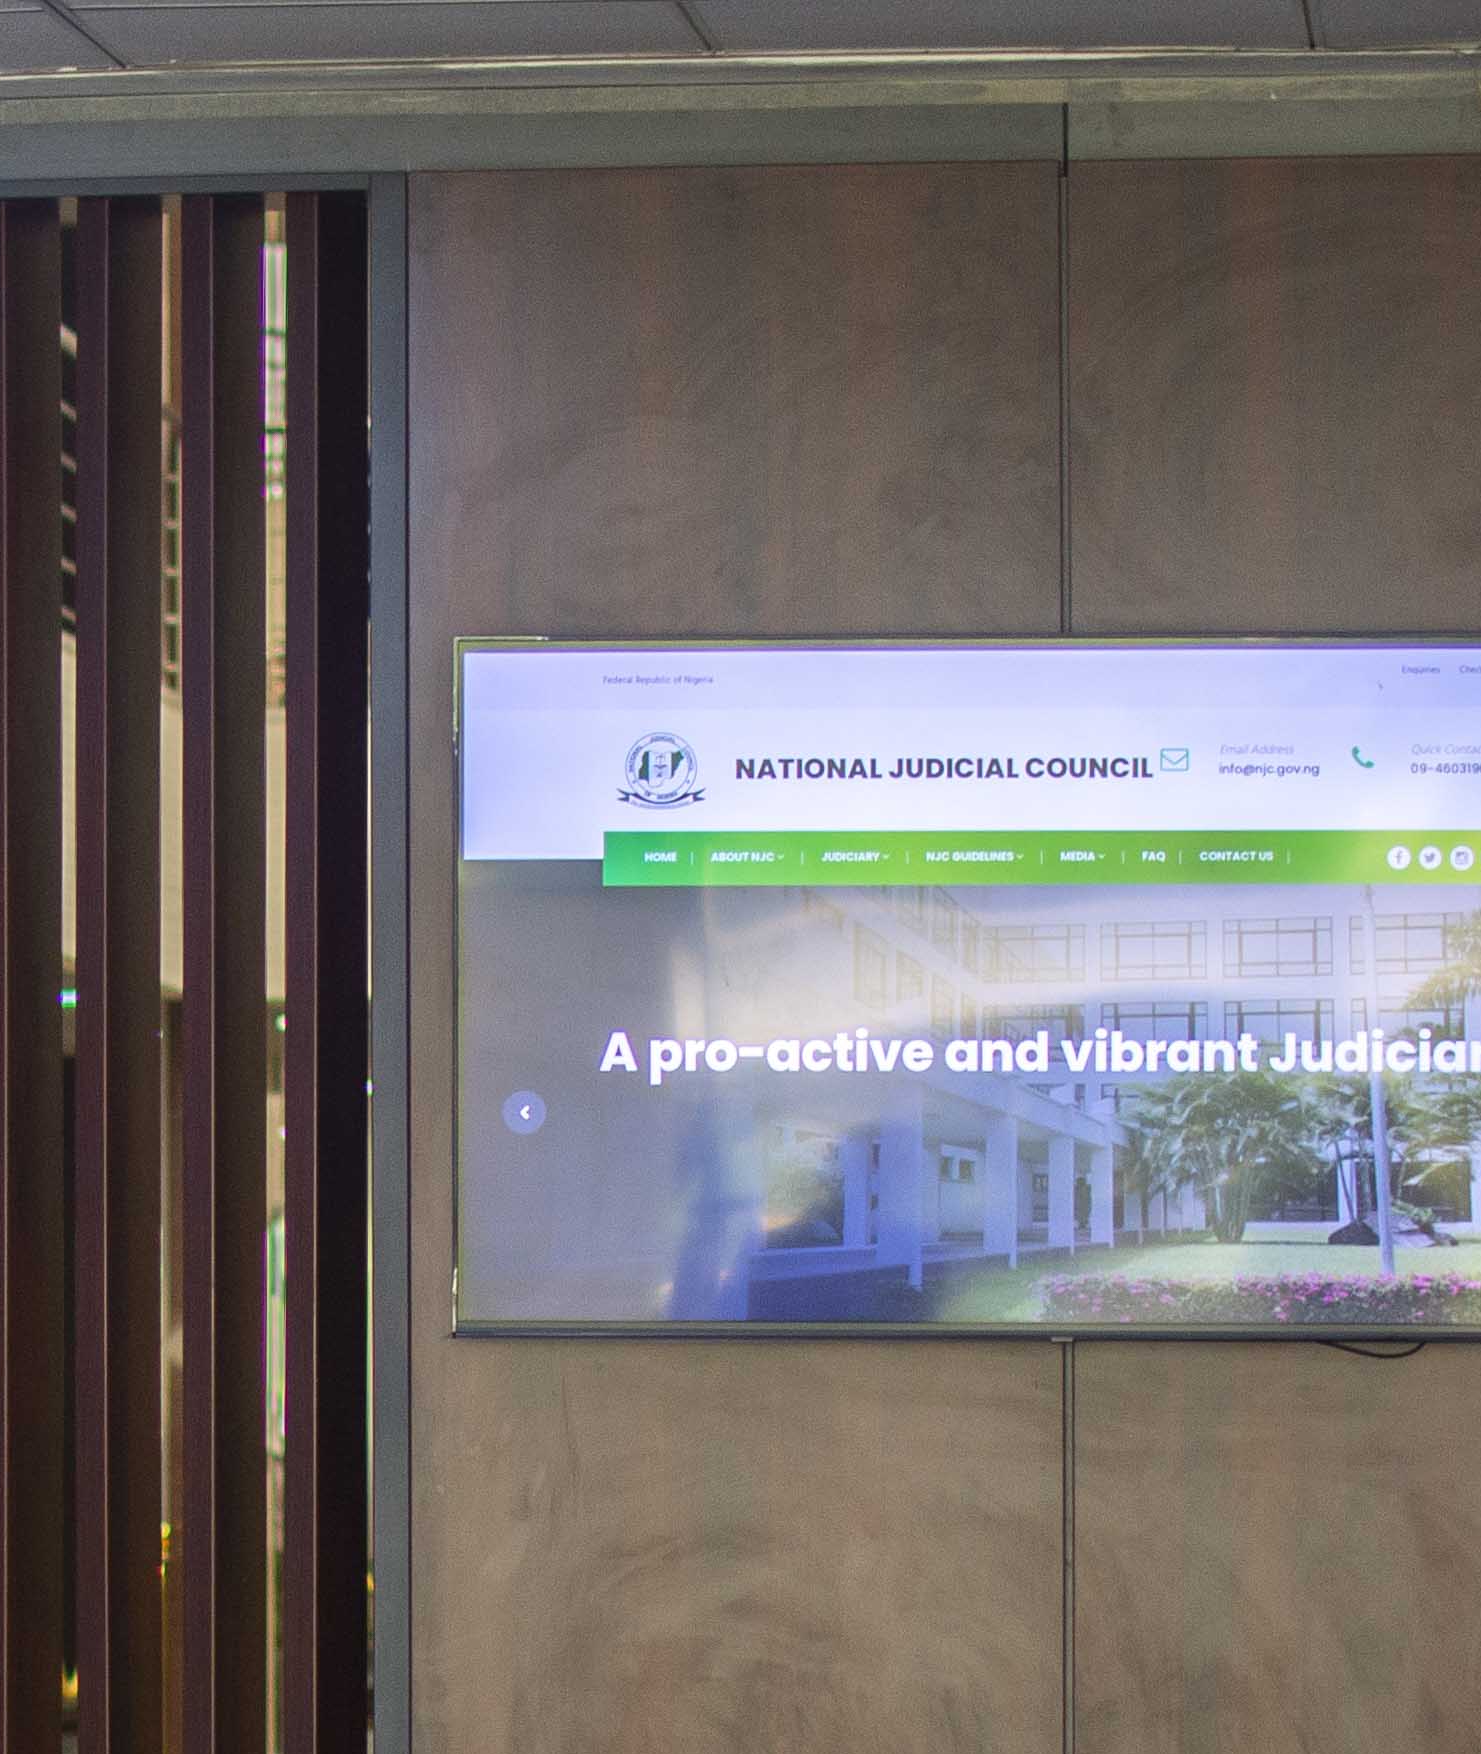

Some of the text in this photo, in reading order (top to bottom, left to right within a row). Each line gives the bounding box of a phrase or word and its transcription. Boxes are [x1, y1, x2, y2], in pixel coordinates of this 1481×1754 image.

[735, 757, 1154, 780] NATIONAL JUDICIAL COUNCIL
[1219, 762, 1321, 777] info@njc.gov.ng
[644, 851, 677, 863] HOME
[710, 851, 775, 863] ABOUT NJC
[821, 851, 879, 863] JUDICIARY
[926, 851, 1014, 862] NJC GUIDELINES
[1060, 851, 1096, 862] MEDIA
[1141, 851, 1166, 863] FAQ
[1199, 850, 1274, 862] CONTACT US
[599, 1031, 638, 1072] A
[649, 1027, 934, 1086] pro-active
[944, 1030, 1049, 1072] and
[1060, 1027, 1258, 1072] vibrant
